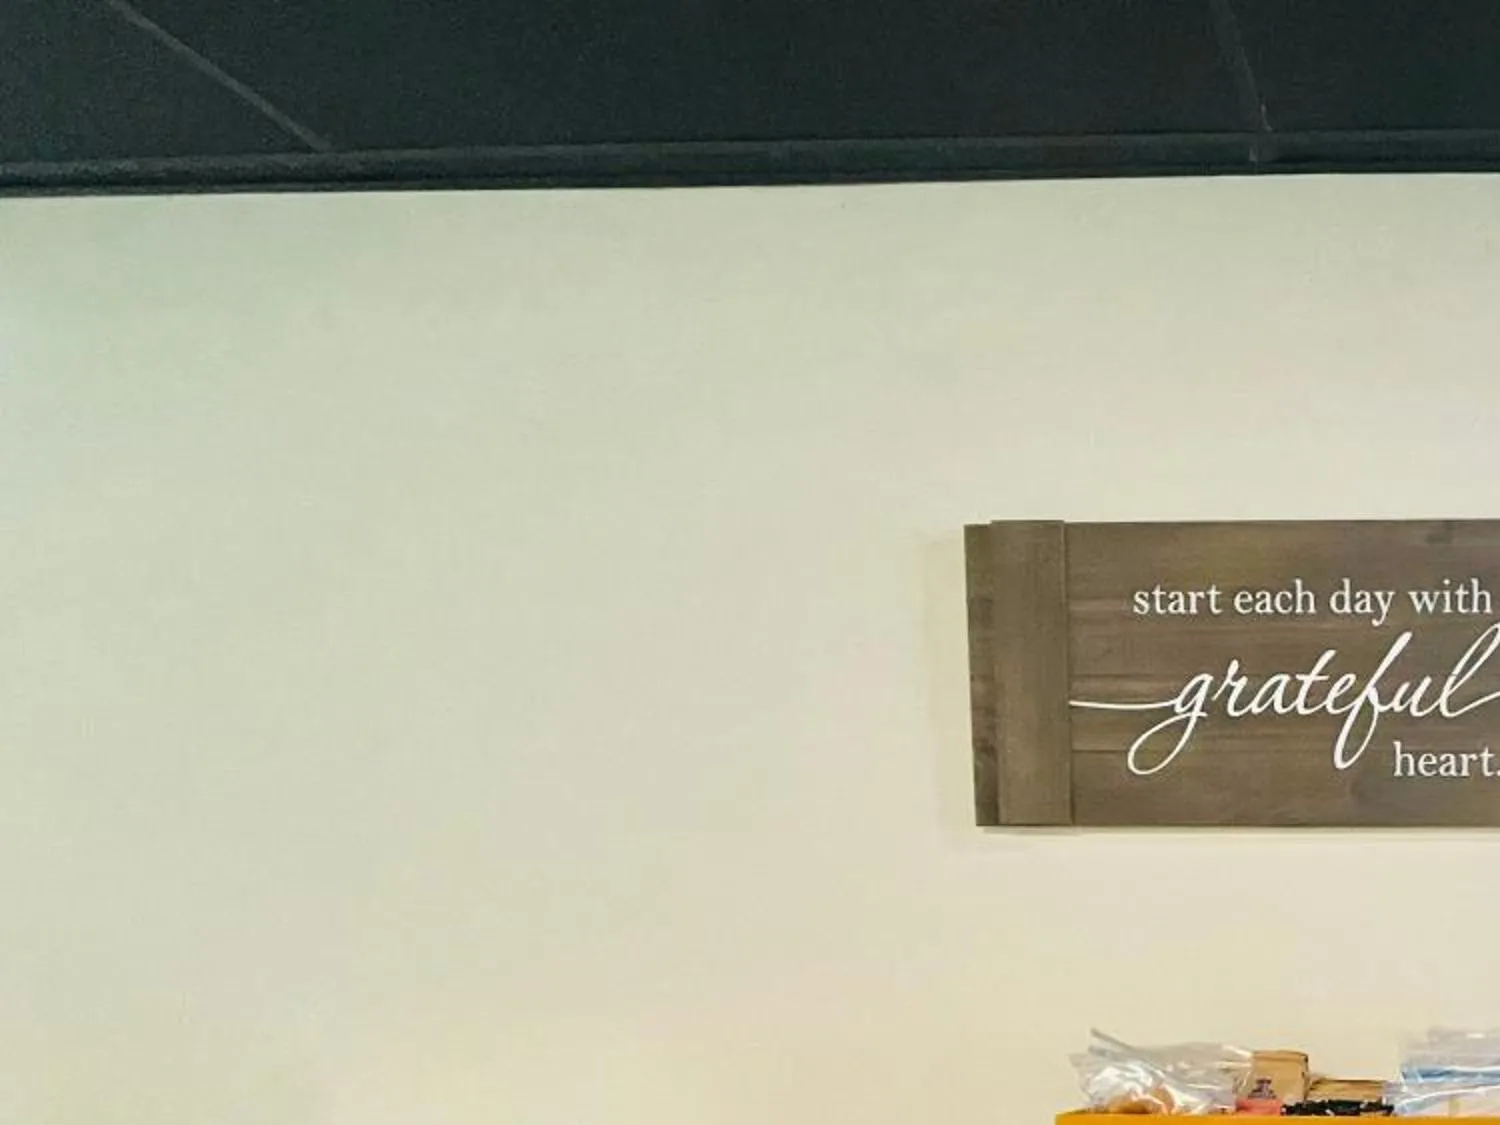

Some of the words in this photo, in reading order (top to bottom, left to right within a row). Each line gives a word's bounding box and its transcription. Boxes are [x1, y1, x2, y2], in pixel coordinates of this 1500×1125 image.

[1133, 584, 1223, 615] start
[1233, 578, 1317, 615] each
[1329, 577, 1396, 627] day
[1407, 578, 1493, 614] with
